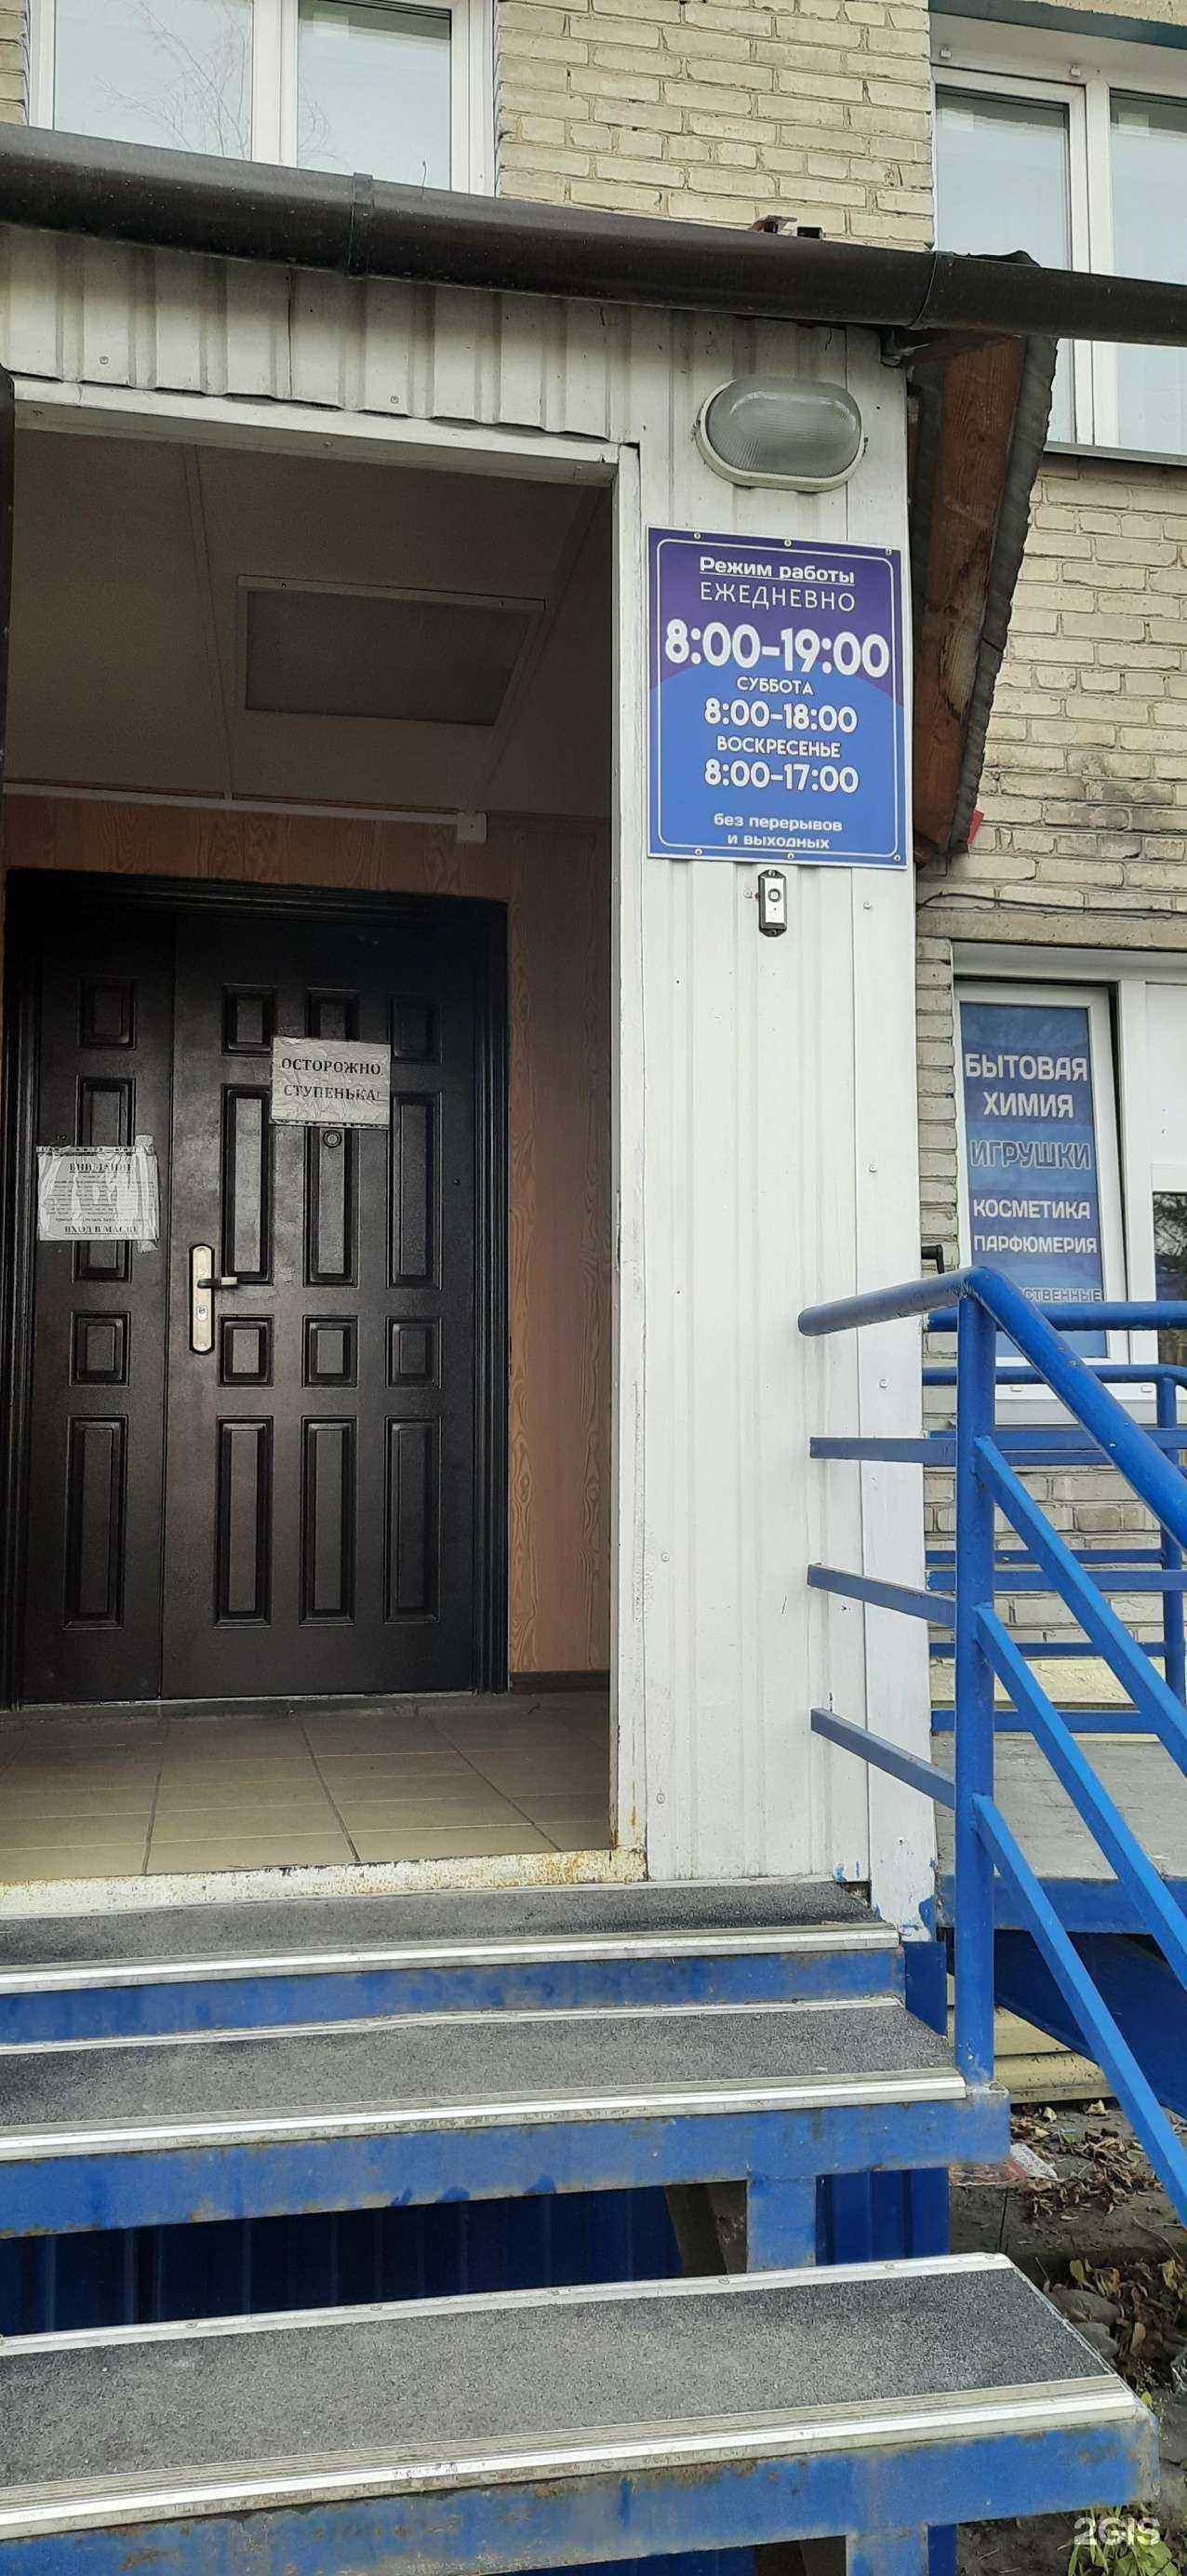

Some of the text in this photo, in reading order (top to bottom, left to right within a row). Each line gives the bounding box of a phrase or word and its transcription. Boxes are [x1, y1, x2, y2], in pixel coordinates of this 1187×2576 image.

[700, 556, 855, 584] Режим работы
[700, 582, 855, 612] ЕЖЕДНЕВНО
[664, 618, 890, 678] 8:00-19:00
[736, 676, 814, 696] СУББОТА
[704, 697, 858, 733] 8:00-18:00
[716, 734, 841, 758] ВОСКРЕСЕНЬЕ
[704, 758, 859, 794] 8:00-17:00
[714, 812, 843, 833] без перерывов
[727, 834, 830, 850] и выходных
[965, 1053, 1087, 1082] БЫТОВАЯ
[982, 1092, 1074, 1119] ХИМИЯ
[969, 1140, 1092, 1171] ИГРУШКИ
[973, 1199, 1090, 1220] КОСМЕТИКА
[974, 1234, 1098, 1254] ПАРФЮМЕРИЯ
[1022, 1286, 1102, 1303] СТВЕННЫЕ
